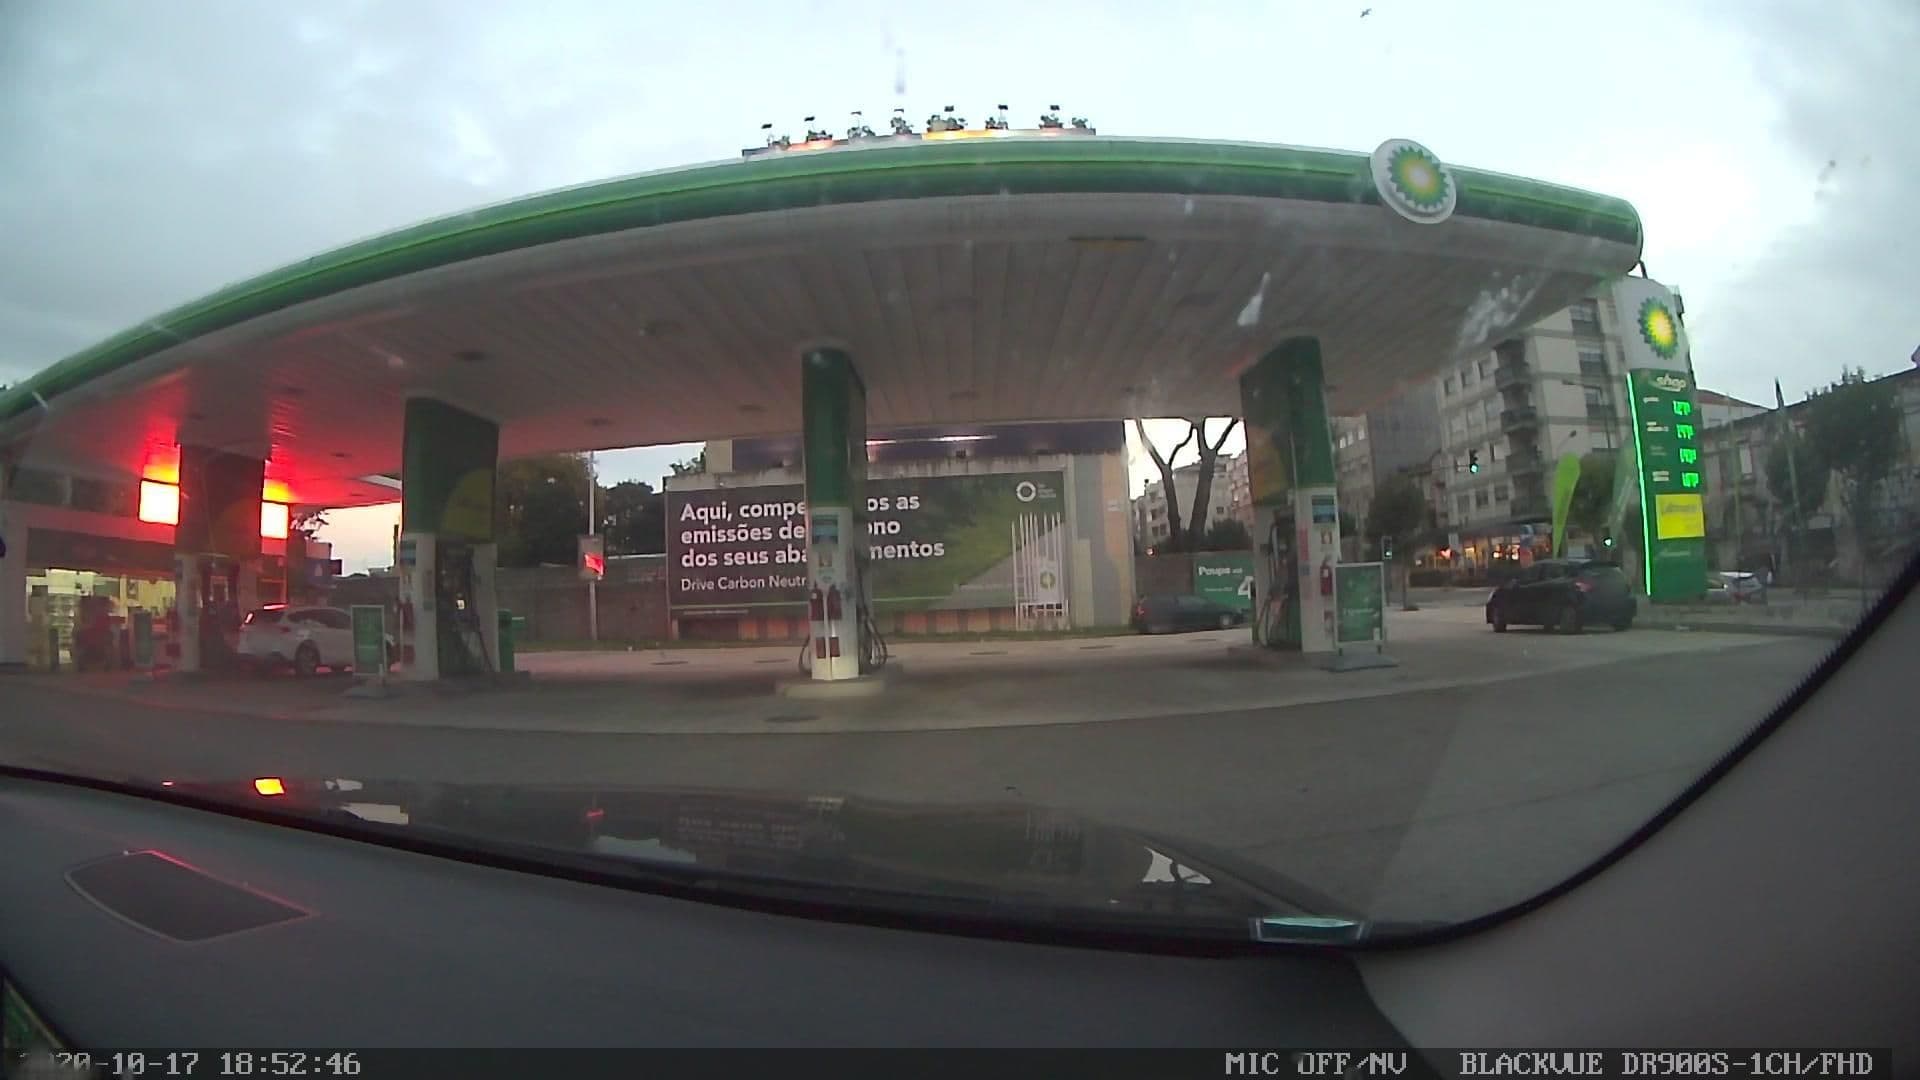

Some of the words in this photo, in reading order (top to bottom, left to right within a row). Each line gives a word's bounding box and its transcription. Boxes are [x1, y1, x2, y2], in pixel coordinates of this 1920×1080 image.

[681, 501, 732, 525] Aqui,
[896, 496, 920, 510] as
[681, 524, 772, 544] emissões
[779, 520, 805, 539] de
[681, 548, 718, 567] dos
[723, 550, 769, 566] seus
[681, 578, 714, 591] Drive
[717, 575, 765, 590] Carbon
[769, 575, 806, 588] Neutr
